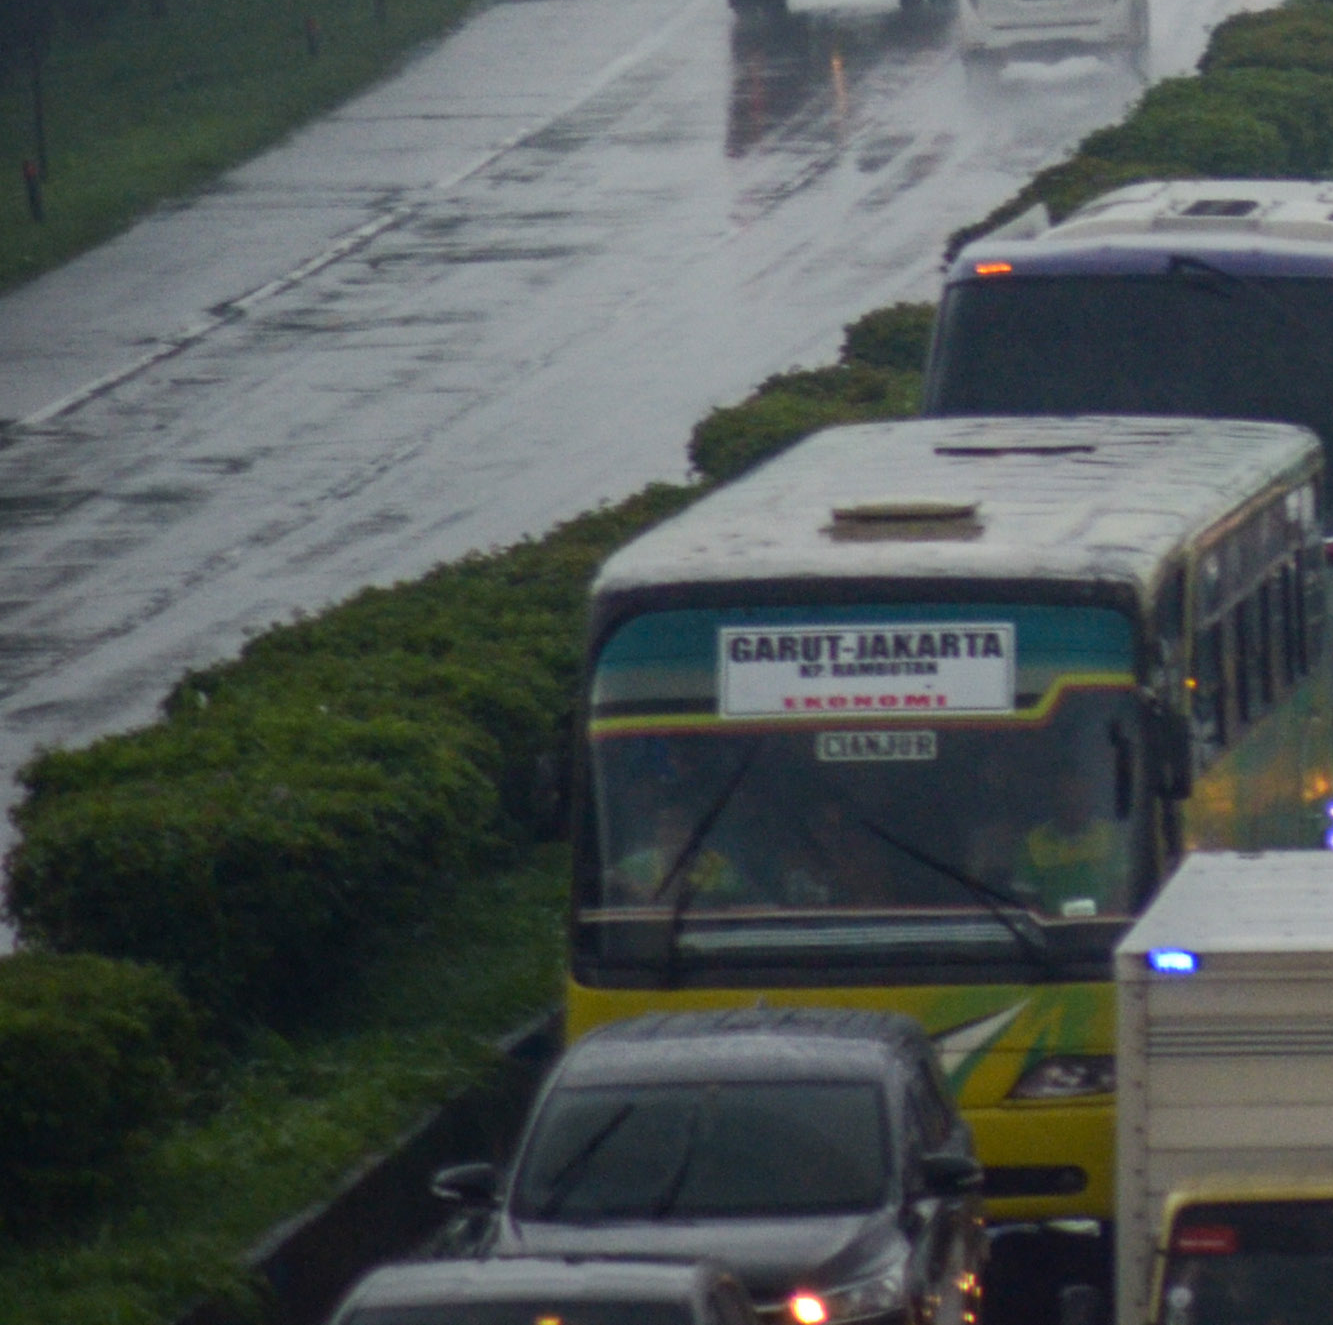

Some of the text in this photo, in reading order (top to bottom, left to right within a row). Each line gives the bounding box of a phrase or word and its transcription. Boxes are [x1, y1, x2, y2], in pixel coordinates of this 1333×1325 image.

[730, 632, 1004, 664] GARUT-JAKARTA
[832, 662, 938, 677] RAMBUTAN
[783, 695, 948, 709] EKONOMI
[824, 734, 933, 758] CIANJUR
